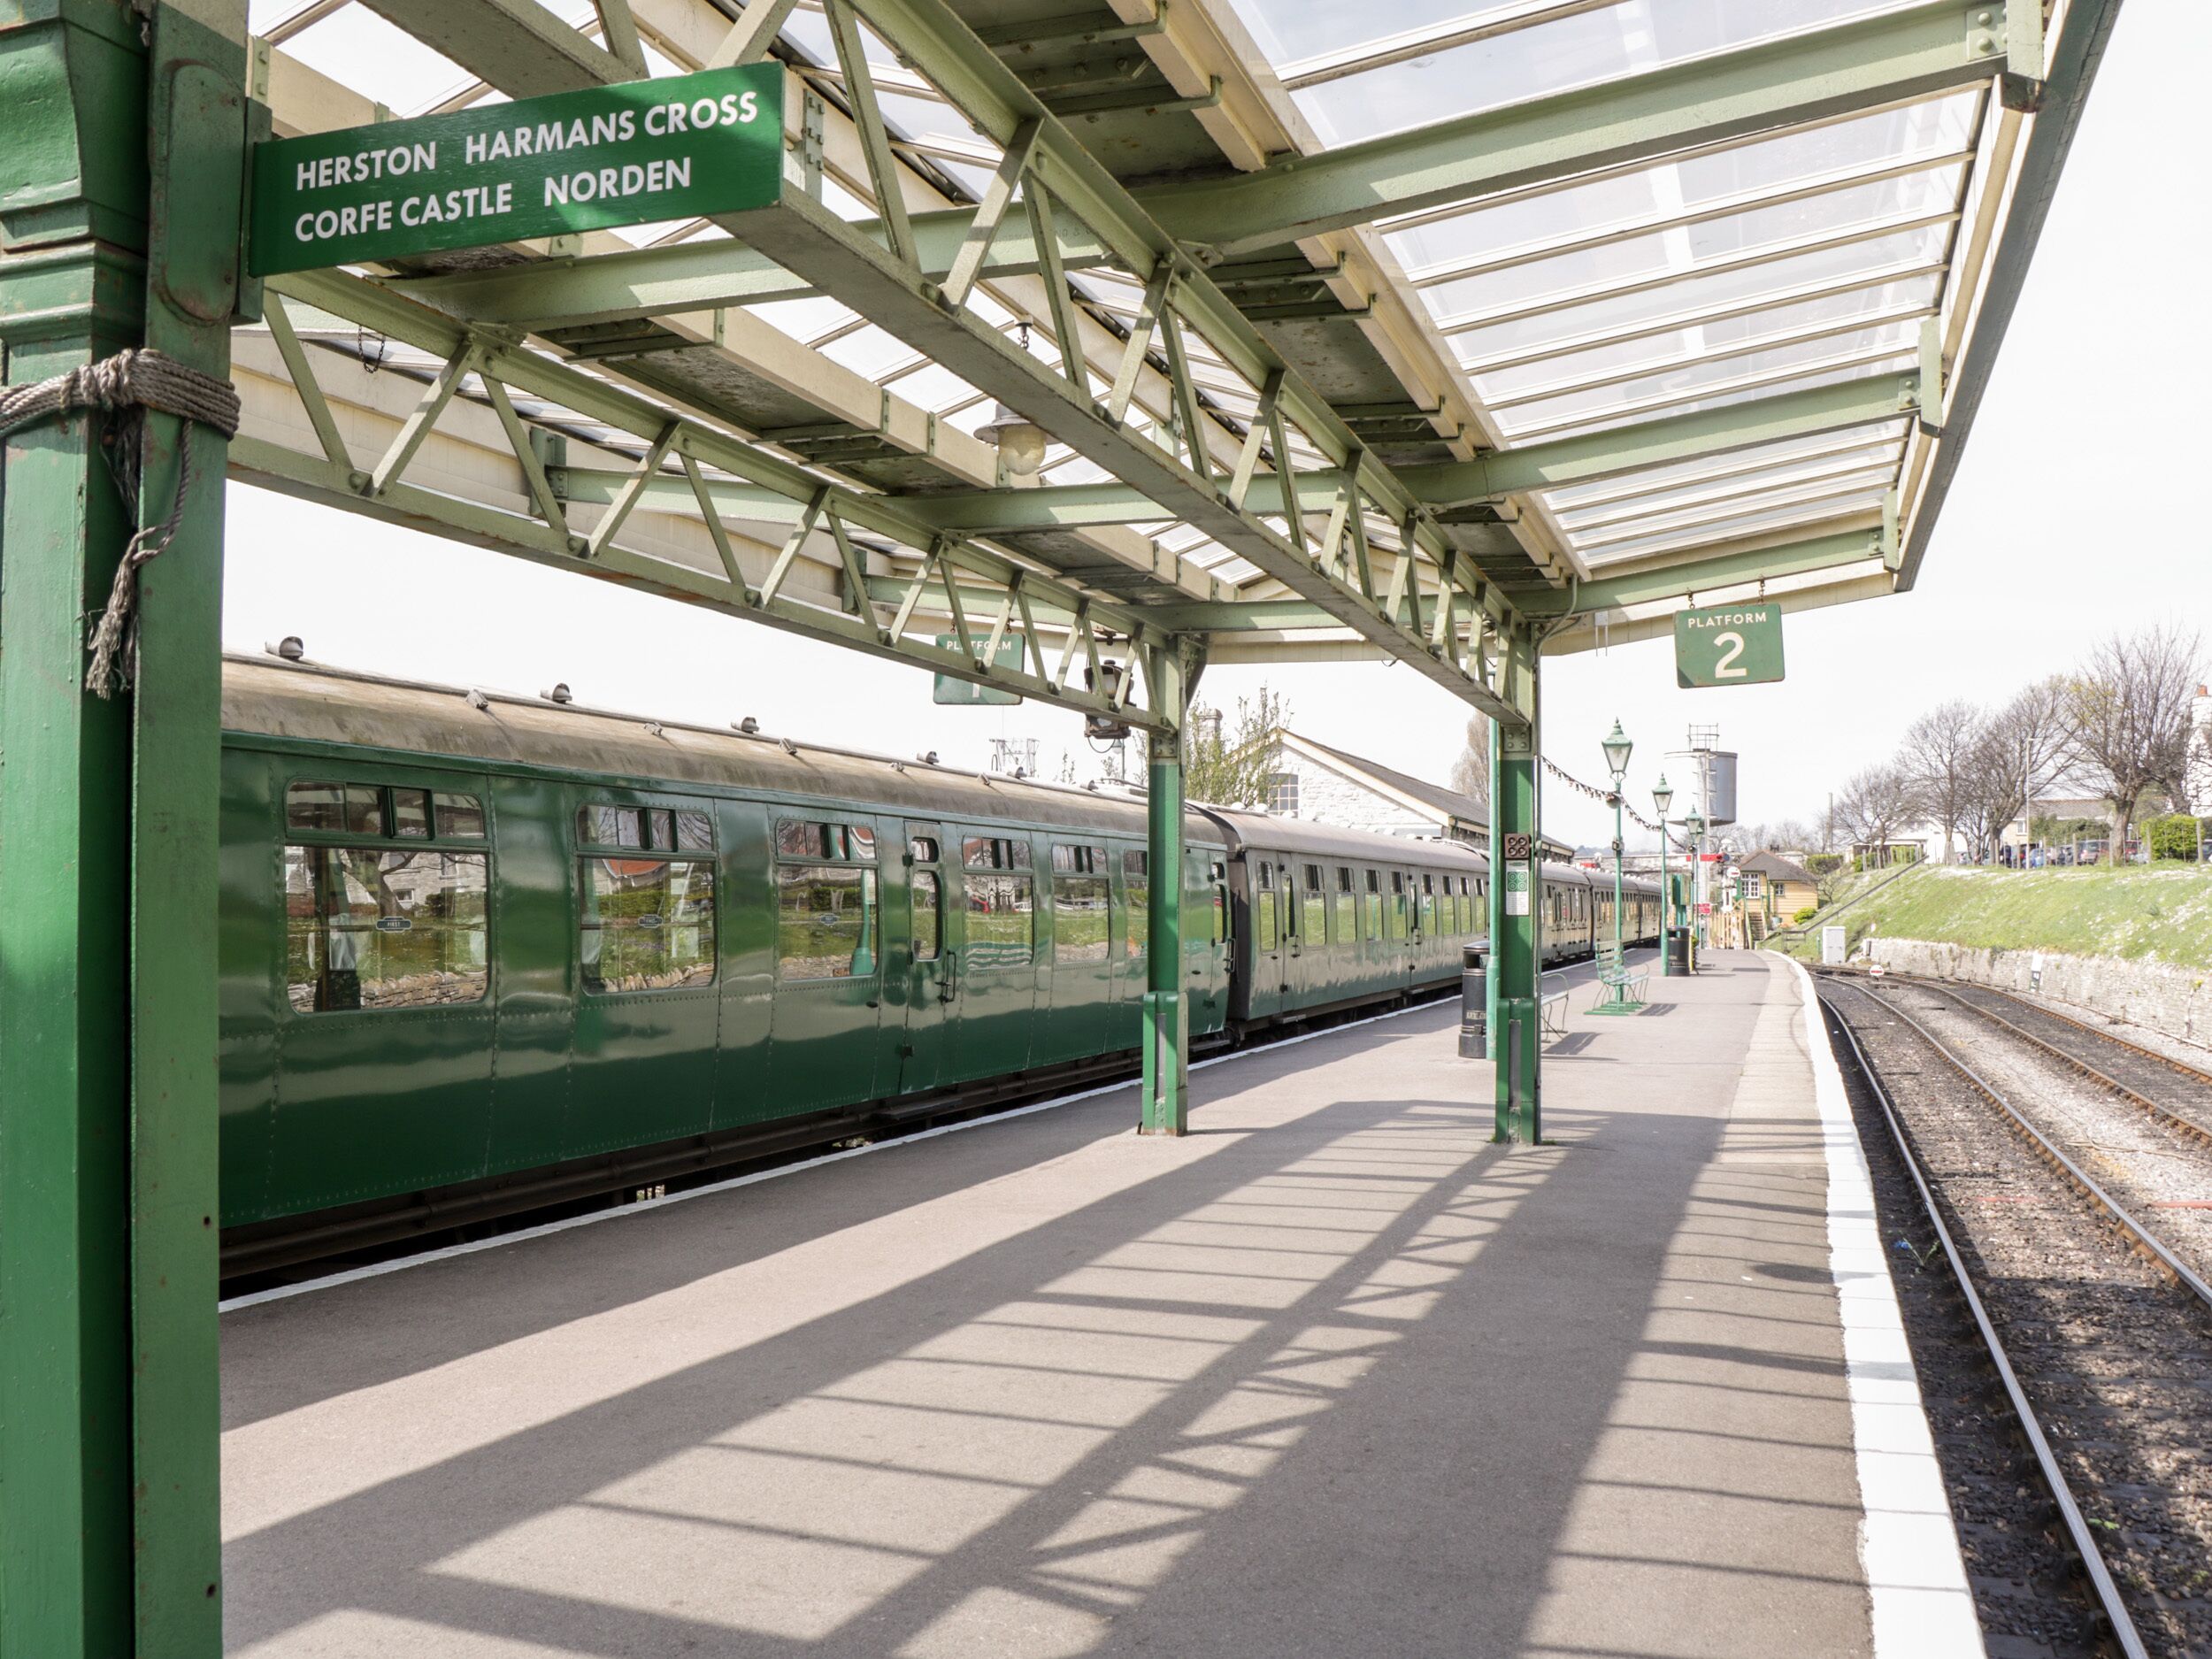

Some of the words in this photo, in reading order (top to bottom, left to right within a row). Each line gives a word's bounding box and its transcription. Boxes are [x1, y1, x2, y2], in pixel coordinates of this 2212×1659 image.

[296, 142, 436, 191] HERSTON
[465, 110, 635, 165] HARMANS
[644, 91, 758, 136] CROSS
[296, 201, 392, 242] CORFE
[400, 183, 512, 227] CASTLE
[543, 157, 690, 207] NORDEN
[1687, 611, 1767, 629] PLATFORM
[946, 640, 1011, 651] PLTFOM
[1713, 632, 1747, 679] 2
